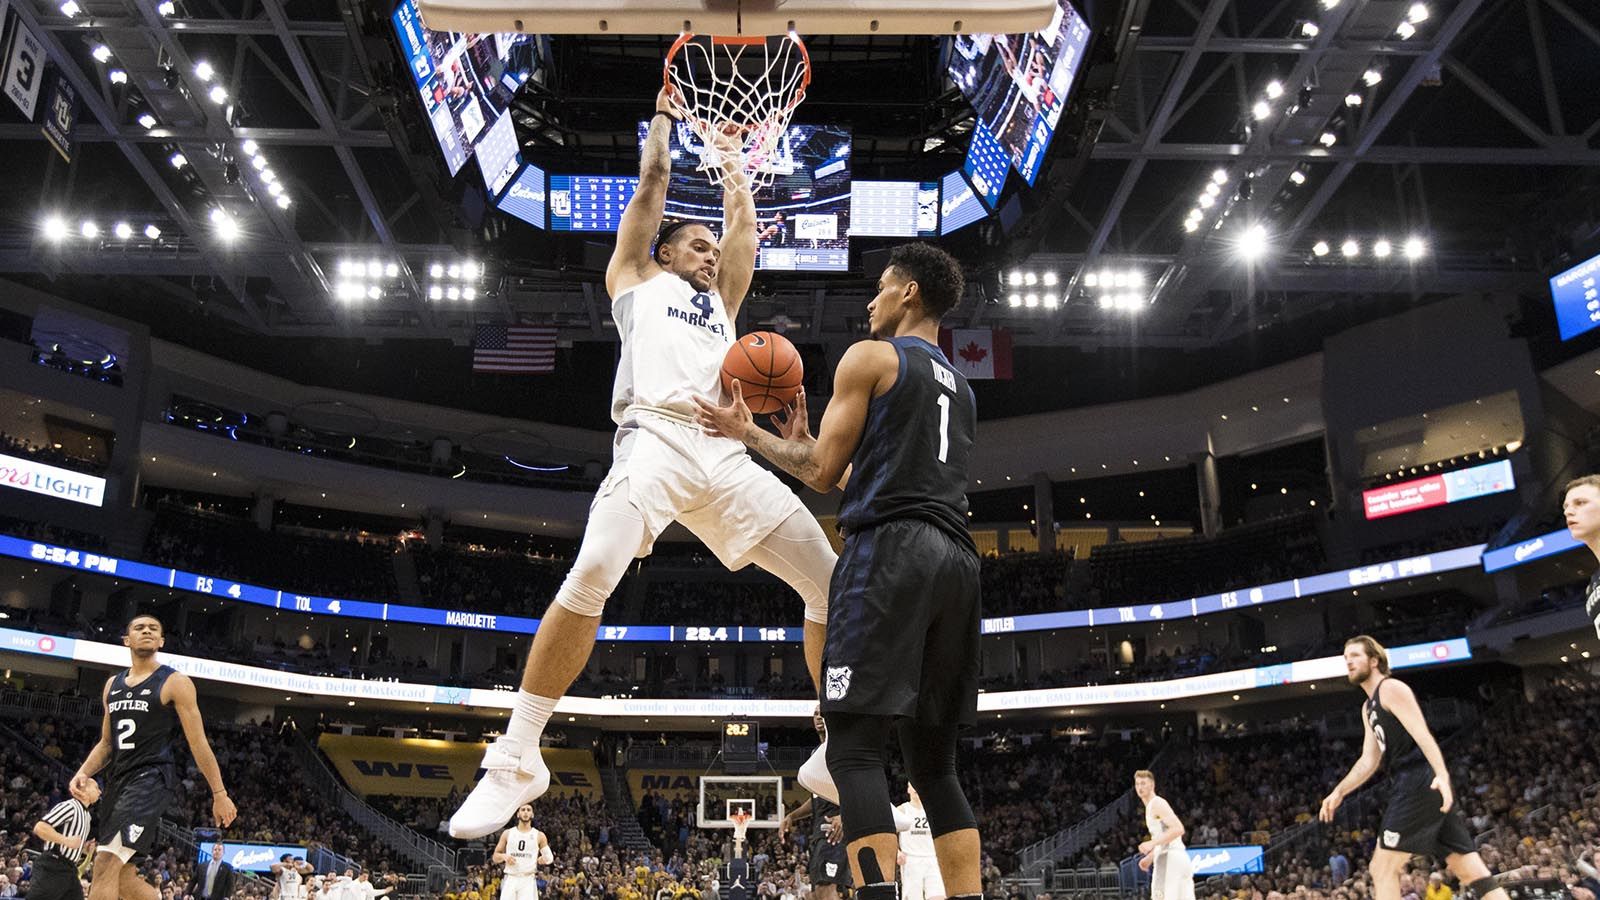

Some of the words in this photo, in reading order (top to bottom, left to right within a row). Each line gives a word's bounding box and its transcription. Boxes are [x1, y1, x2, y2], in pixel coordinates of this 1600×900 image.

[16, 50, 36, 92] 3
[690, 294, 714, 320] 4
[937, 393, 949, 463] 1
[34, 474, 94, 499] LIGHT
[31, 543, 80, 566] 8:54
[84, 554, 118, 574] PM
[1397, 556, 1431, 577] PM
[196, 576, 214, 594] FLS
[228, 584, 242, 599] 4
[295, 596, 313, 612] TOL
[327, 600, 341, 614] 4
[984, 617, 1015, 633] BUTLER
[1118, 607, 1136, 622] TOL
[1150, 605, 1164, 619] 4
[1221, 592, 1238, 608] FLS
[446, 611, 497, 629] MARQUETTE
[604, 627, 628, 640] 27
[758, 628, 786, 641] 1st
[194, 661, 214, 675] the
[219, 668, 246, 680] BMO
[250, 674, 283, 687] Harris
[287, 678, 321, 691] Bucks
[325, 682, 357, 693] Debit
[362, 684, 426, 699] Mastercard
[1000, 697, 1021, 706] Get
[1023, 695, 1042, 704] the
[1046, 692, 1071, 704] BMO
[1076, 689, 1110, 701] Harris
[1113, 687, 1147, 698] Bucks
[1152, 684, 1181, 696] Debit
[1185, 675, 1247, 692] Mastercard
[108, 700, 149, 713] BUTLER
[624, 702, 668, 712] Consider
[672, 704, 699, 715] your
[700, 702, 727, 712] other
[733, 702, 760, 712] cards
[117, 719, 136, 749] 2
[352, 760, 454, 781] WE
[914, 817, 928, 829] 22
[518, 839, 526, 851] 0
